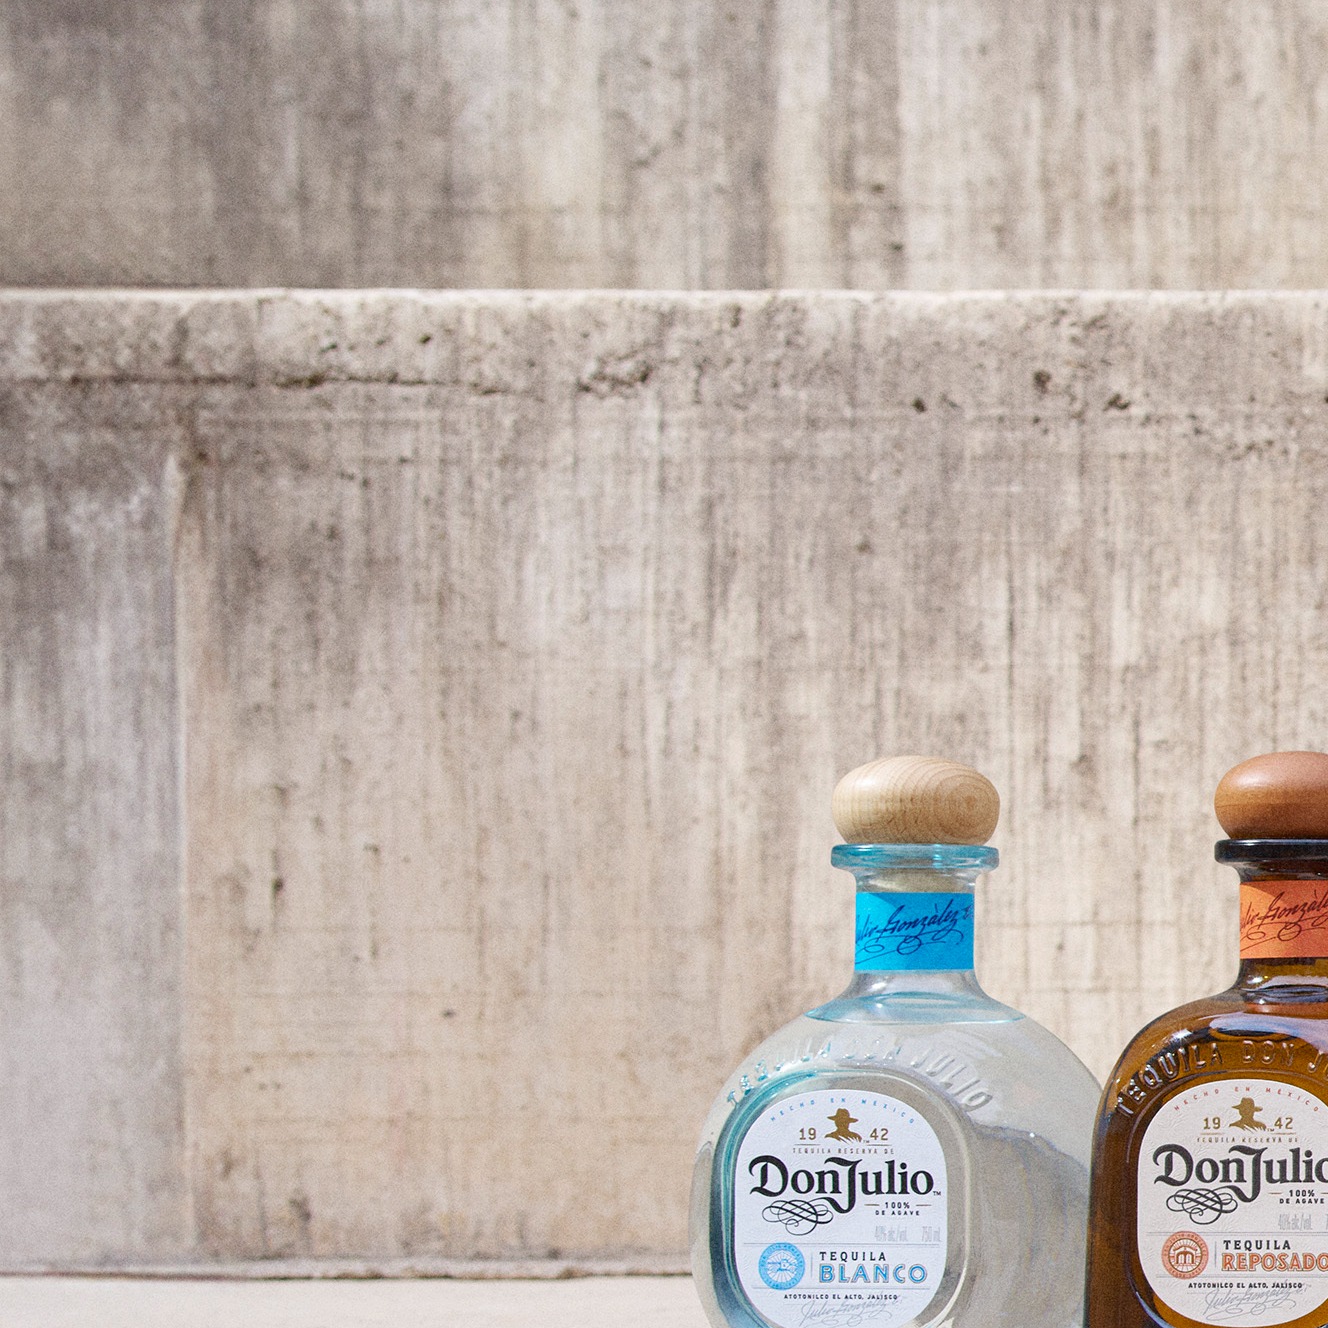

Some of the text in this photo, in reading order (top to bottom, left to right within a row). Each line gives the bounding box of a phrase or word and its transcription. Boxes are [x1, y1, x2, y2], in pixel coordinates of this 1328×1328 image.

[1115, 1041, 1223, 1118] TEQUILA
[1242, 1040, 1295, 1068] DON
[1174, 1088, 1220, 1112] HECHO
[770, 1099, 815, 1122] HECHO
[1203, 1116, 1293, 1130] 19 42
[799, 1127, 889, 1141] 19 42
[885, 1201, 910, 1209] 100%
[1223, 1239, 1291, 1251] TEQUILA
[819, 1251, 887, 1262] TEQUILA
[818, 1263, 928, 1284] BLANCO
